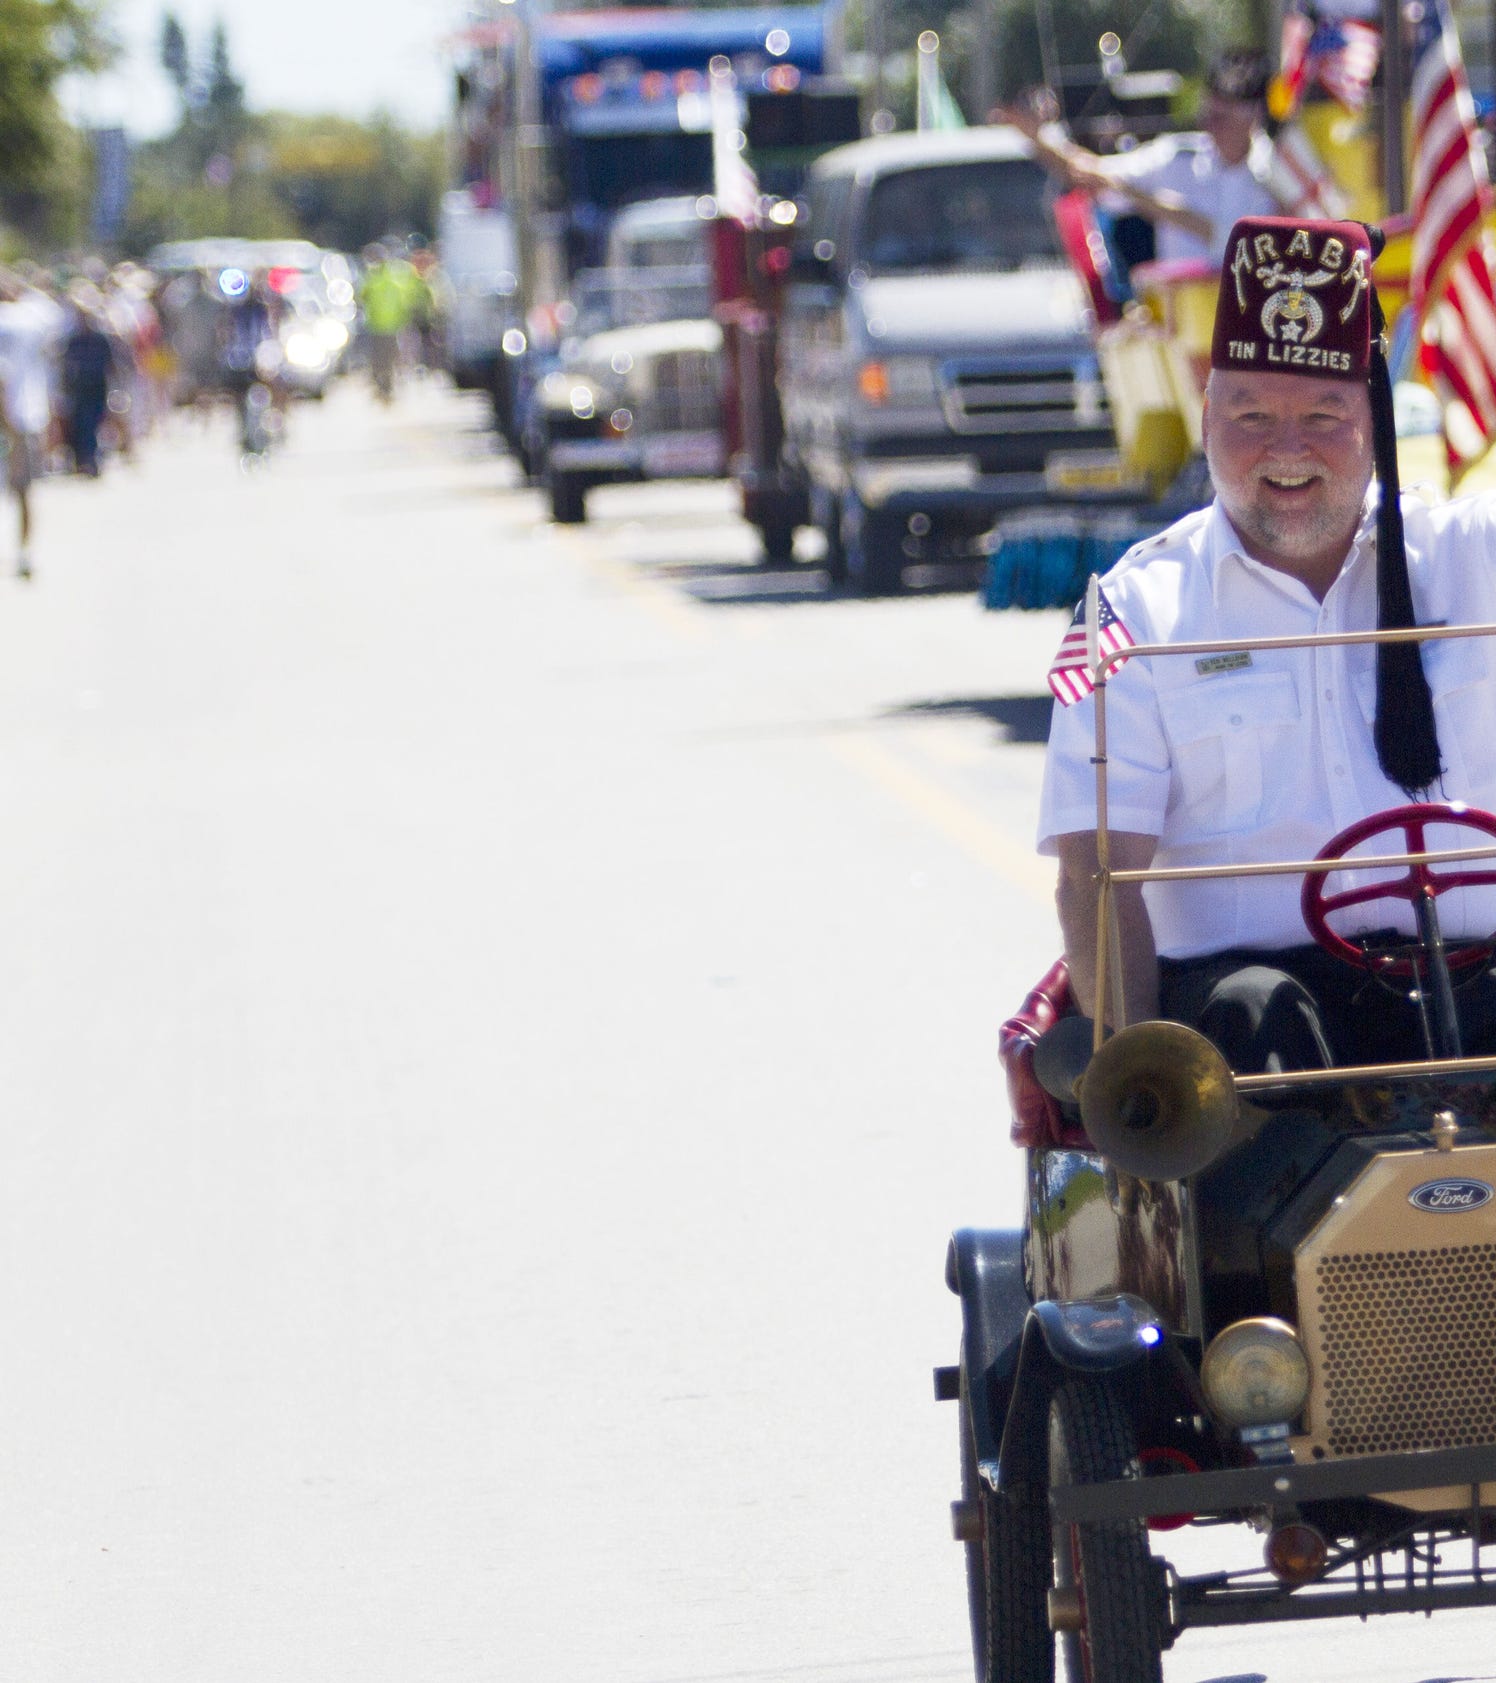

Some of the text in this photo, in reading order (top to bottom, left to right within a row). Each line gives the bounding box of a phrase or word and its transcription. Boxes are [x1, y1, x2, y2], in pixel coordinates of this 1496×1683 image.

[1230, 229, 1370, 318] ARABA
[1228, 340, 1352, 371] TIN LIZZIES
[1429, 1186, 1474, 1206] Ford
